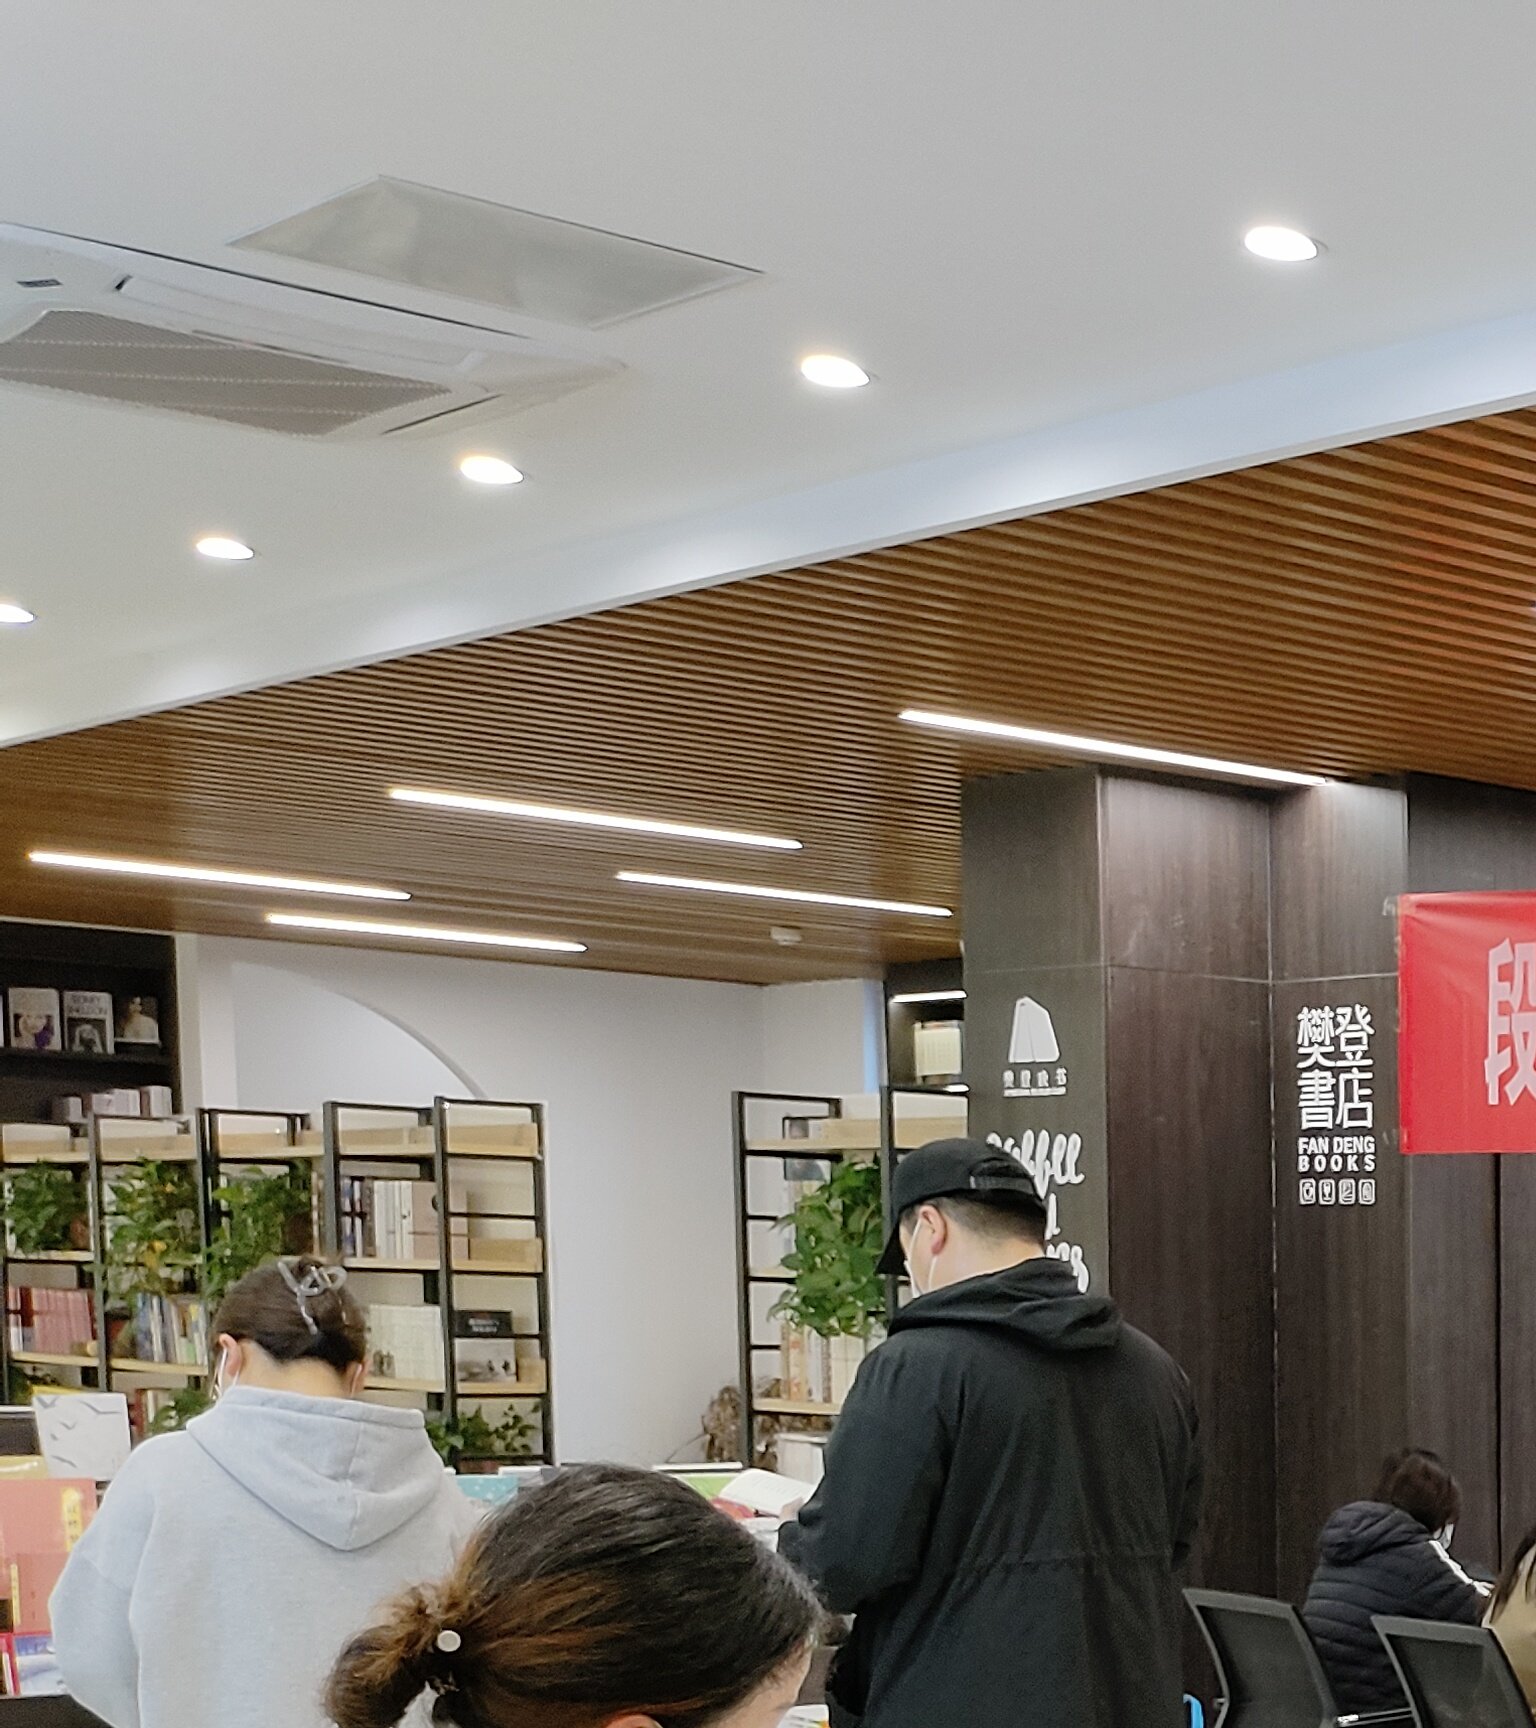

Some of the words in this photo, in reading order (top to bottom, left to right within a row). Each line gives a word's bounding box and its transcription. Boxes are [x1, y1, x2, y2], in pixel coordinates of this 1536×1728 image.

[1297, 1003, 1375, 1068] 樊登
[1297, 1069, 1374, 1130] 書店
[1298, 1136, 1329, 1154] FAN
[1333, 1136, 1375, 1154] DENG
[1298, 1154, 1376, 1172] BOOKS
